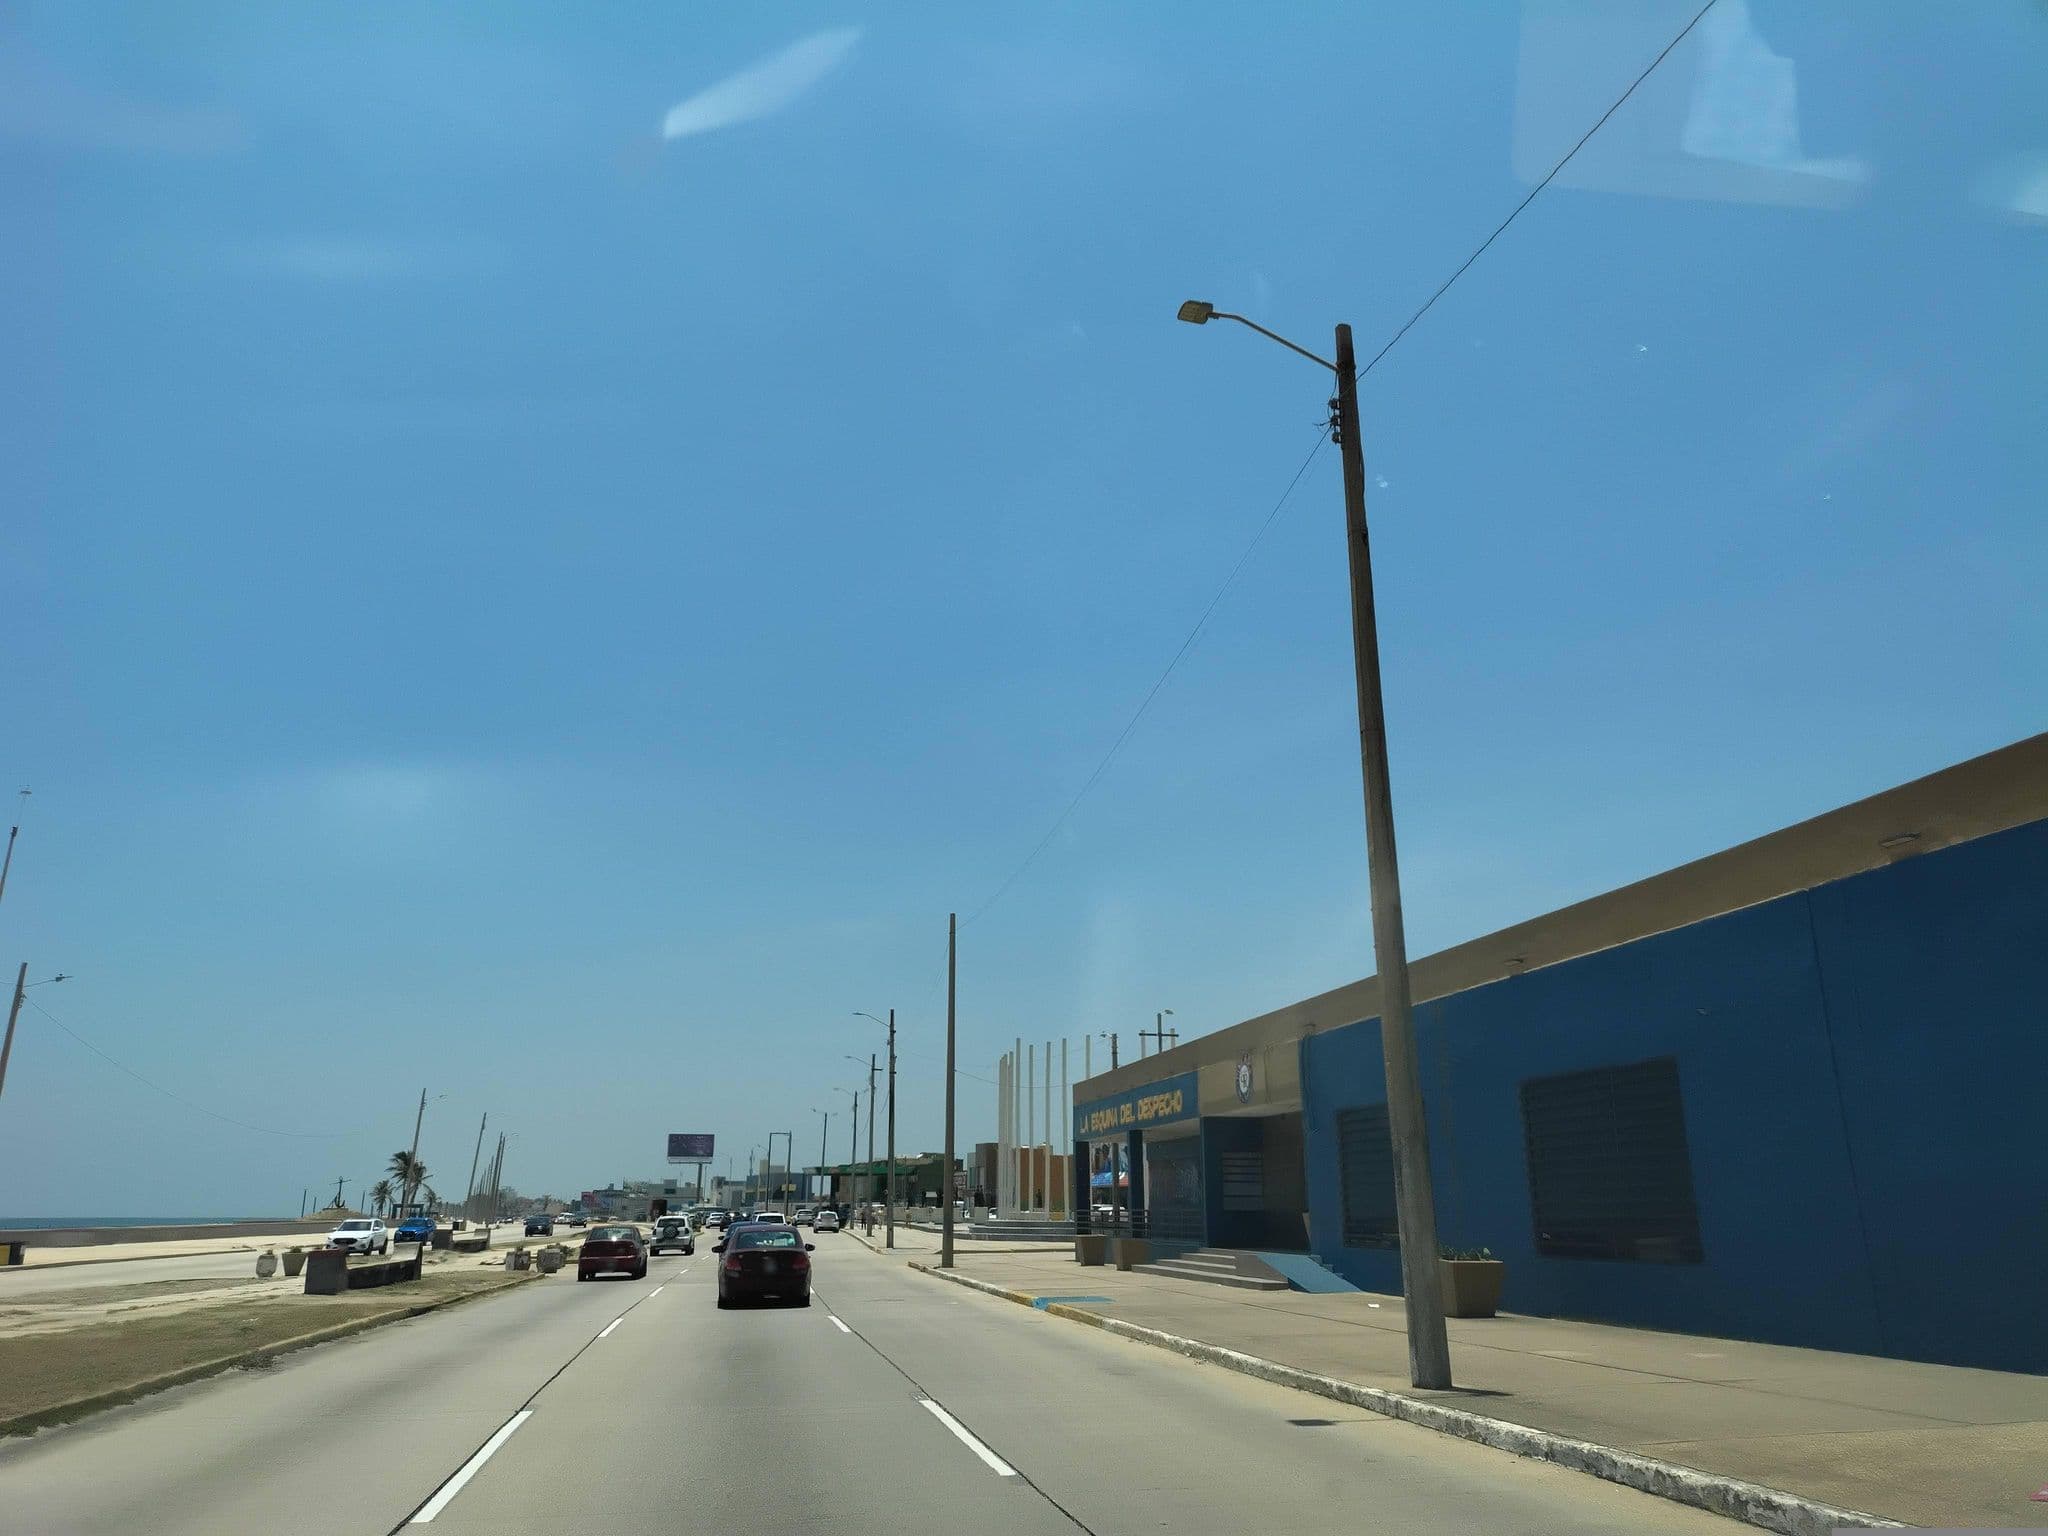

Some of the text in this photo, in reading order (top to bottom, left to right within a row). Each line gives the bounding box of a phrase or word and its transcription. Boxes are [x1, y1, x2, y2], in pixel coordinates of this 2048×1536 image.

[1080, 1089, 1183, 1133] LA ESQUINA DEL DESPECHO
